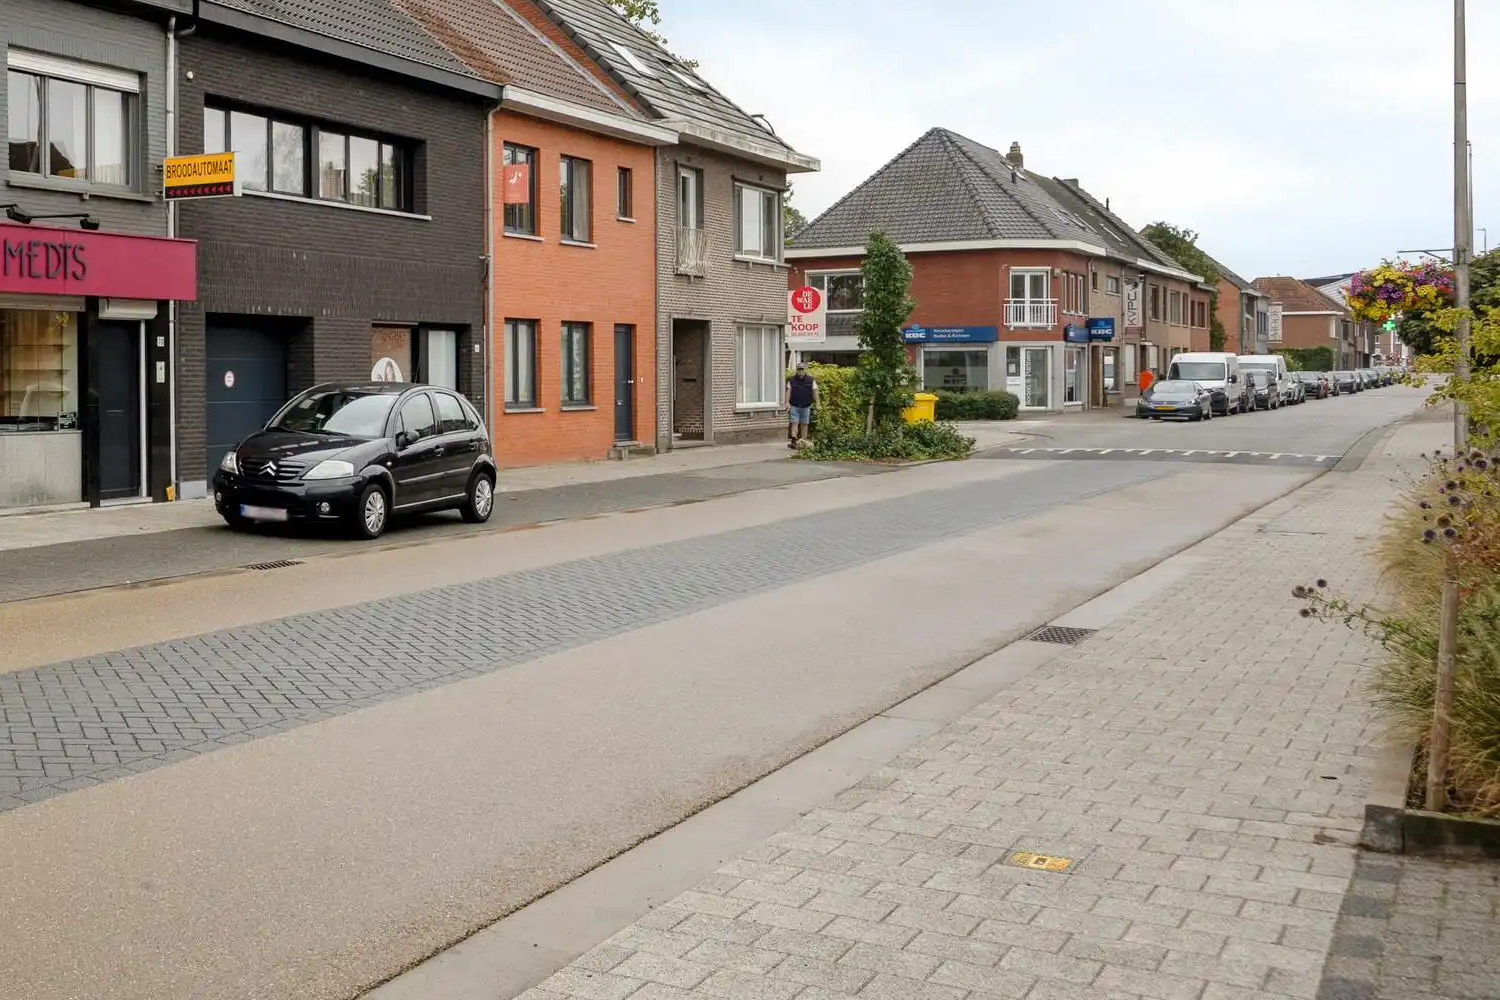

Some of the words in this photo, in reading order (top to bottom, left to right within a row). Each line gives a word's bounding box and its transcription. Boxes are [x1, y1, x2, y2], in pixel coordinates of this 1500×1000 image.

[166, 159, 233, 179] BROODAUTOMAAT
[3, 237, 87, 281] MEDTS
[790, 315, 803, 323] TE
[791, 323, 819, 331] KOOP
